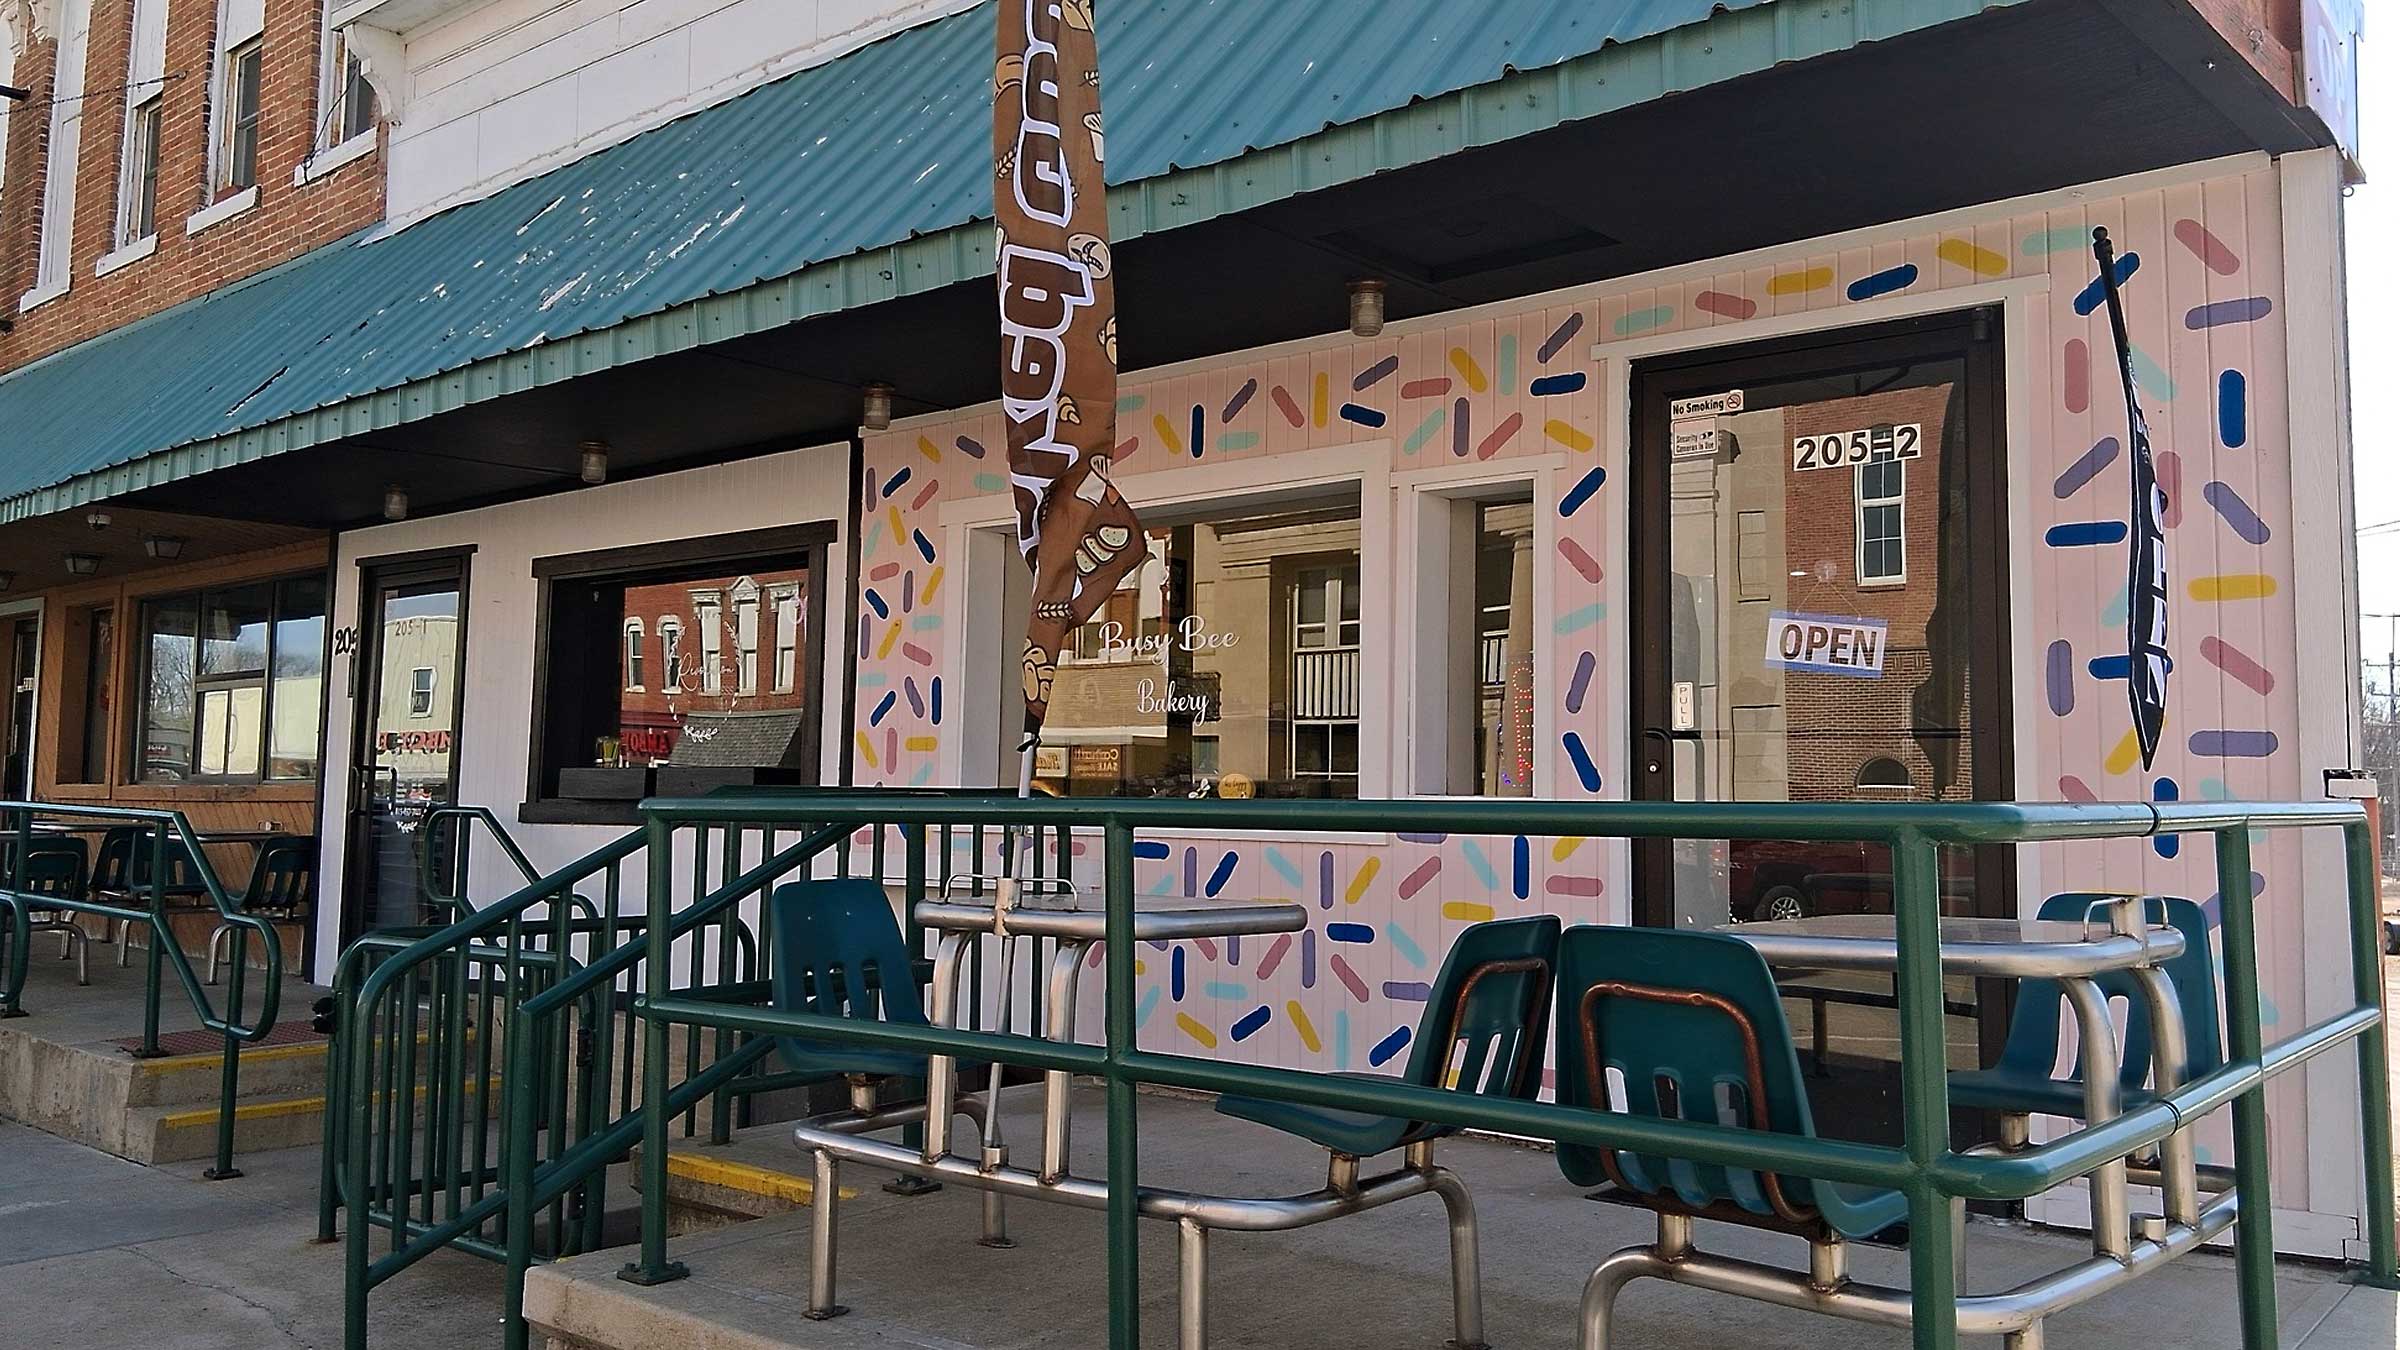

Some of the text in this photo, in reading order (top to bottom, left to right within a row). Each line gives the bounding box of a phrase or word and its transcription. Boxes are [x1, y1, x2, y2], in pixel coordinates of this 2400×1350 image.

[1673, 399, 1724, 415] No Smoking
[395, 619, 427, 637] 205-1
[1099, 615, 1240, 665] Busy Bee
[1779, 623, 1878, 668] OPEN
[1137, 678, 1211, 727] Bakery
[1679, 687, 1688, 724] PULL
